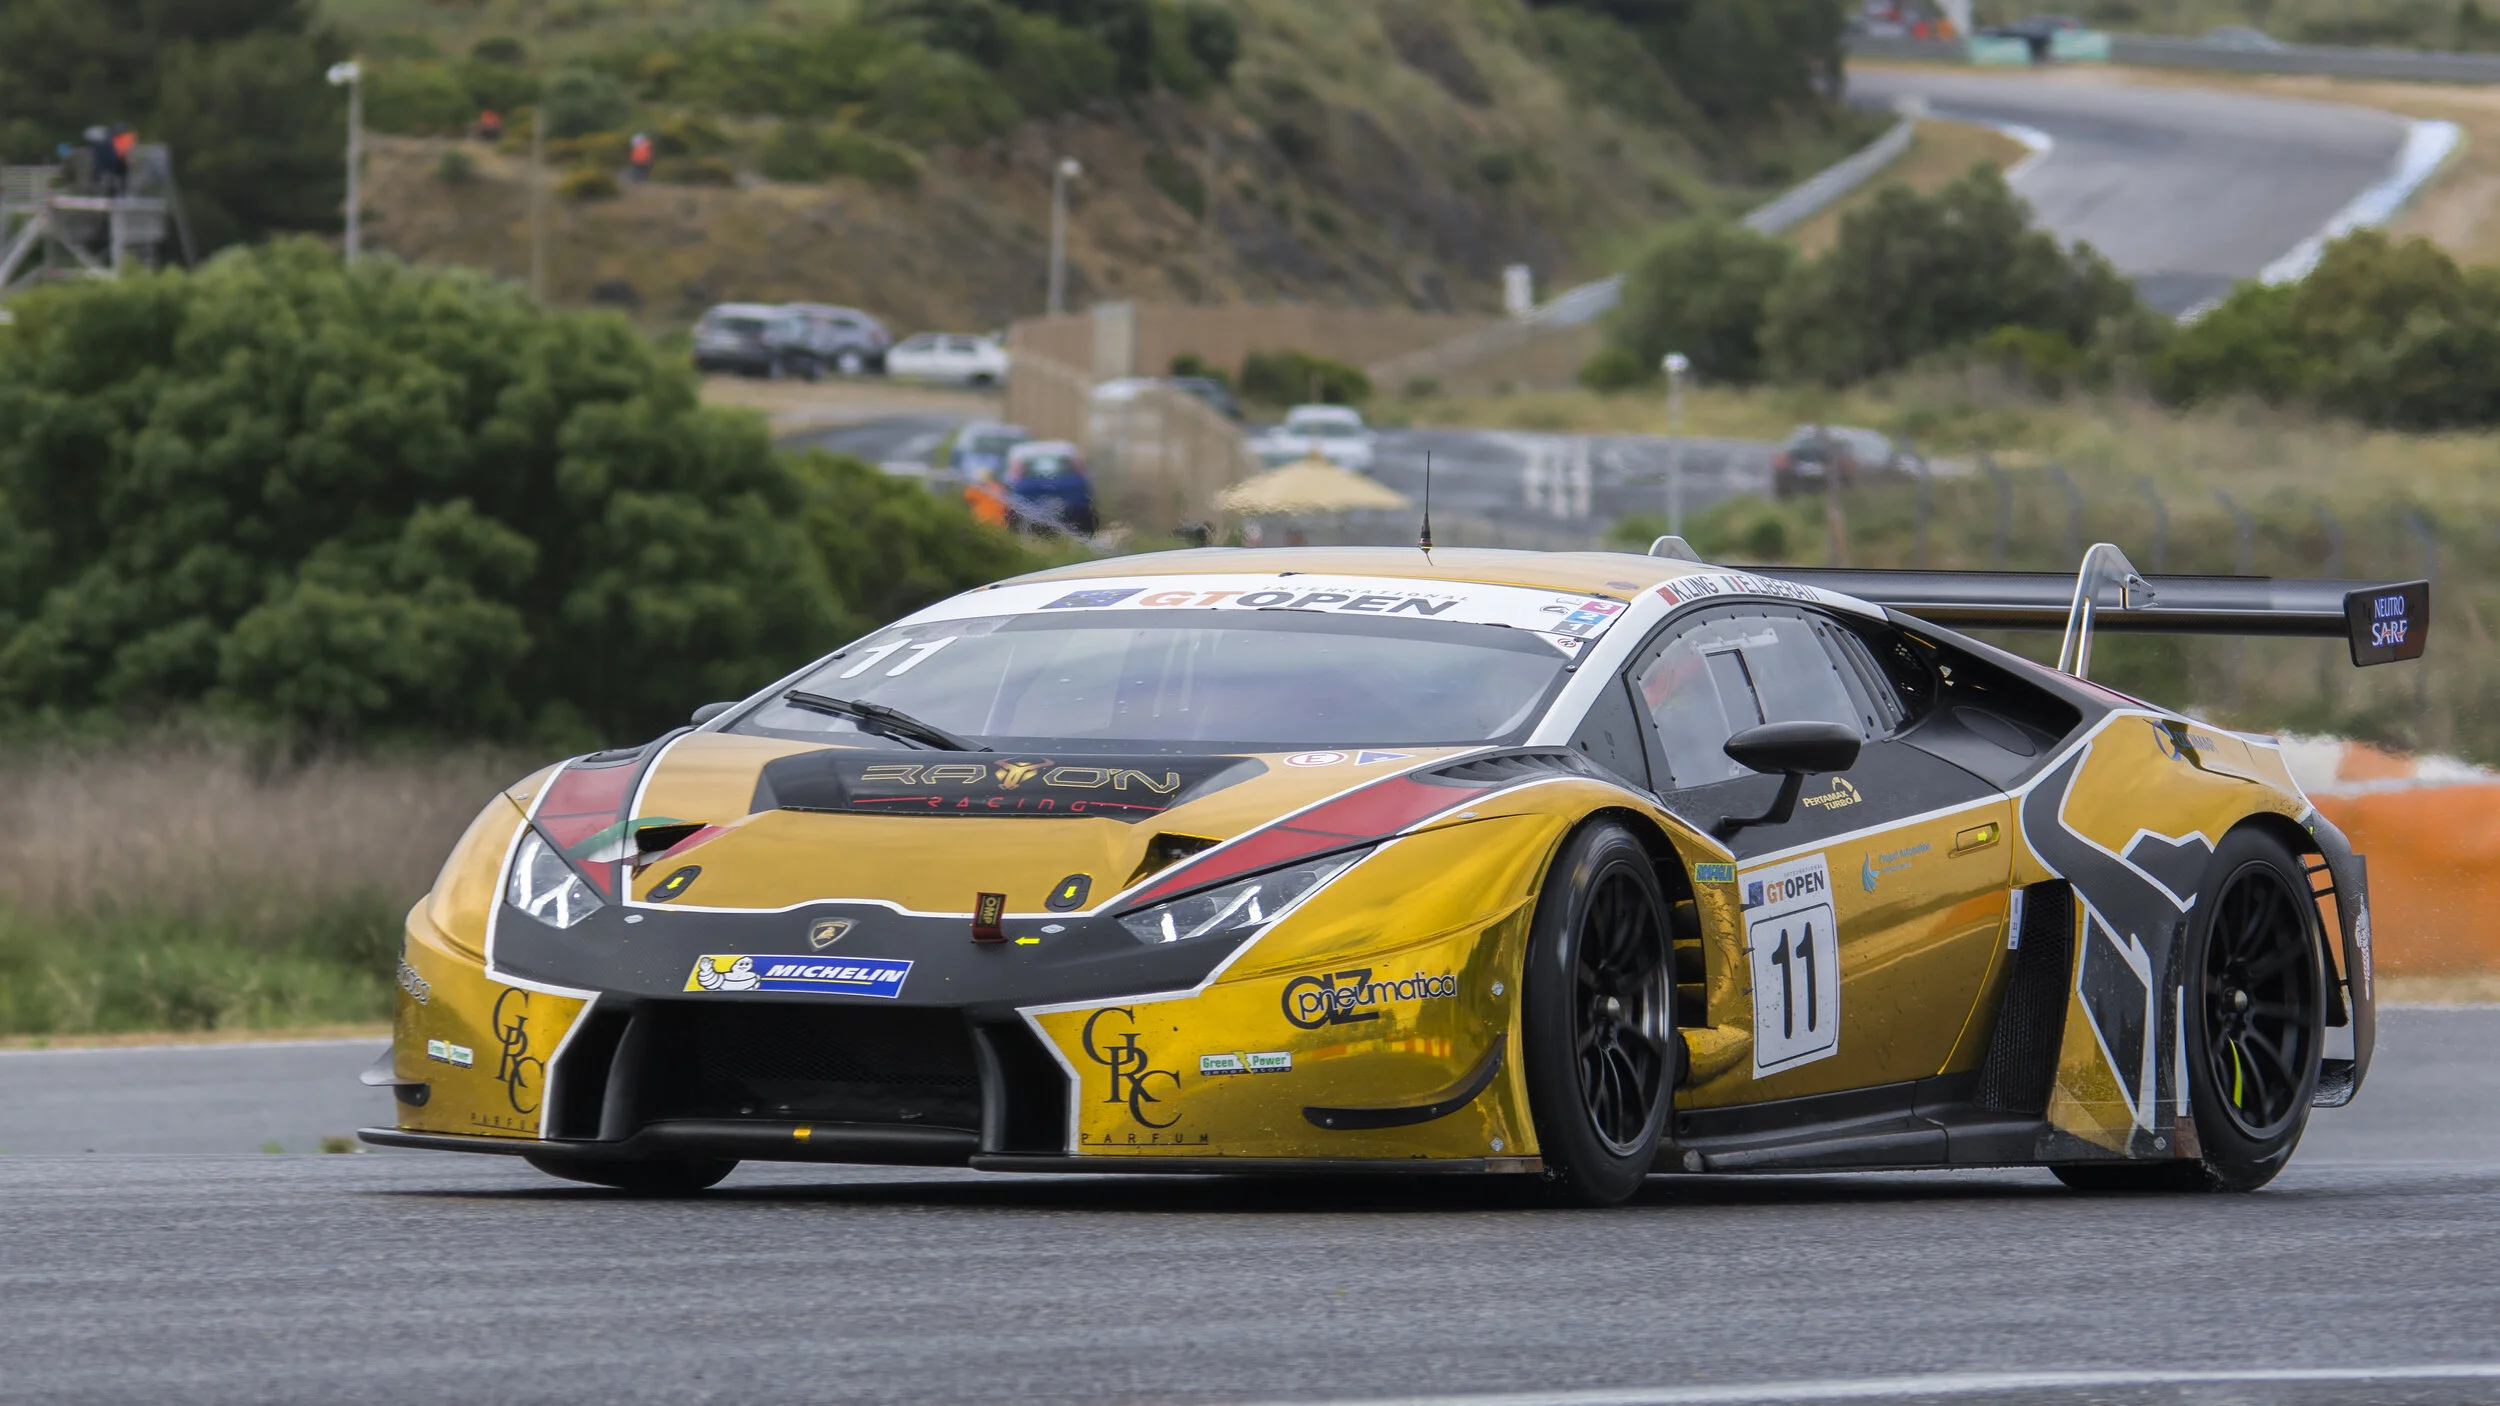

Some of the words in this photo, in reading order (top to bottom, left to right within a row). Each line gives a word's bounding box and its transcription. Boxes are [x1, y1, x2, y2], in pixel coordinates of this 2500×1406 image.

[1262, 585, 1472, 601] INTERNATIONAL
[2374, 595, 2405, 618] NEUTRO
[839, 635, 959, 679] 11
[1304, 754, 1327, 764] E
[1802, 790, 1849, 808] PERTAMAX
[1823, 797, 1854, 811] TURBO
[983, 896, 997, 925] OMP
[765, 964, 905, 983] MICHELIN
[1771, 921, 1817, 1040] 11
[1297, 971, 1458, 1022] pneumatica
[1202, 1057, 1234, 1069] Green
[1252, 1055, 1287, 1067] Power
[1081, 1133, 1209, 1144] PARFUM
